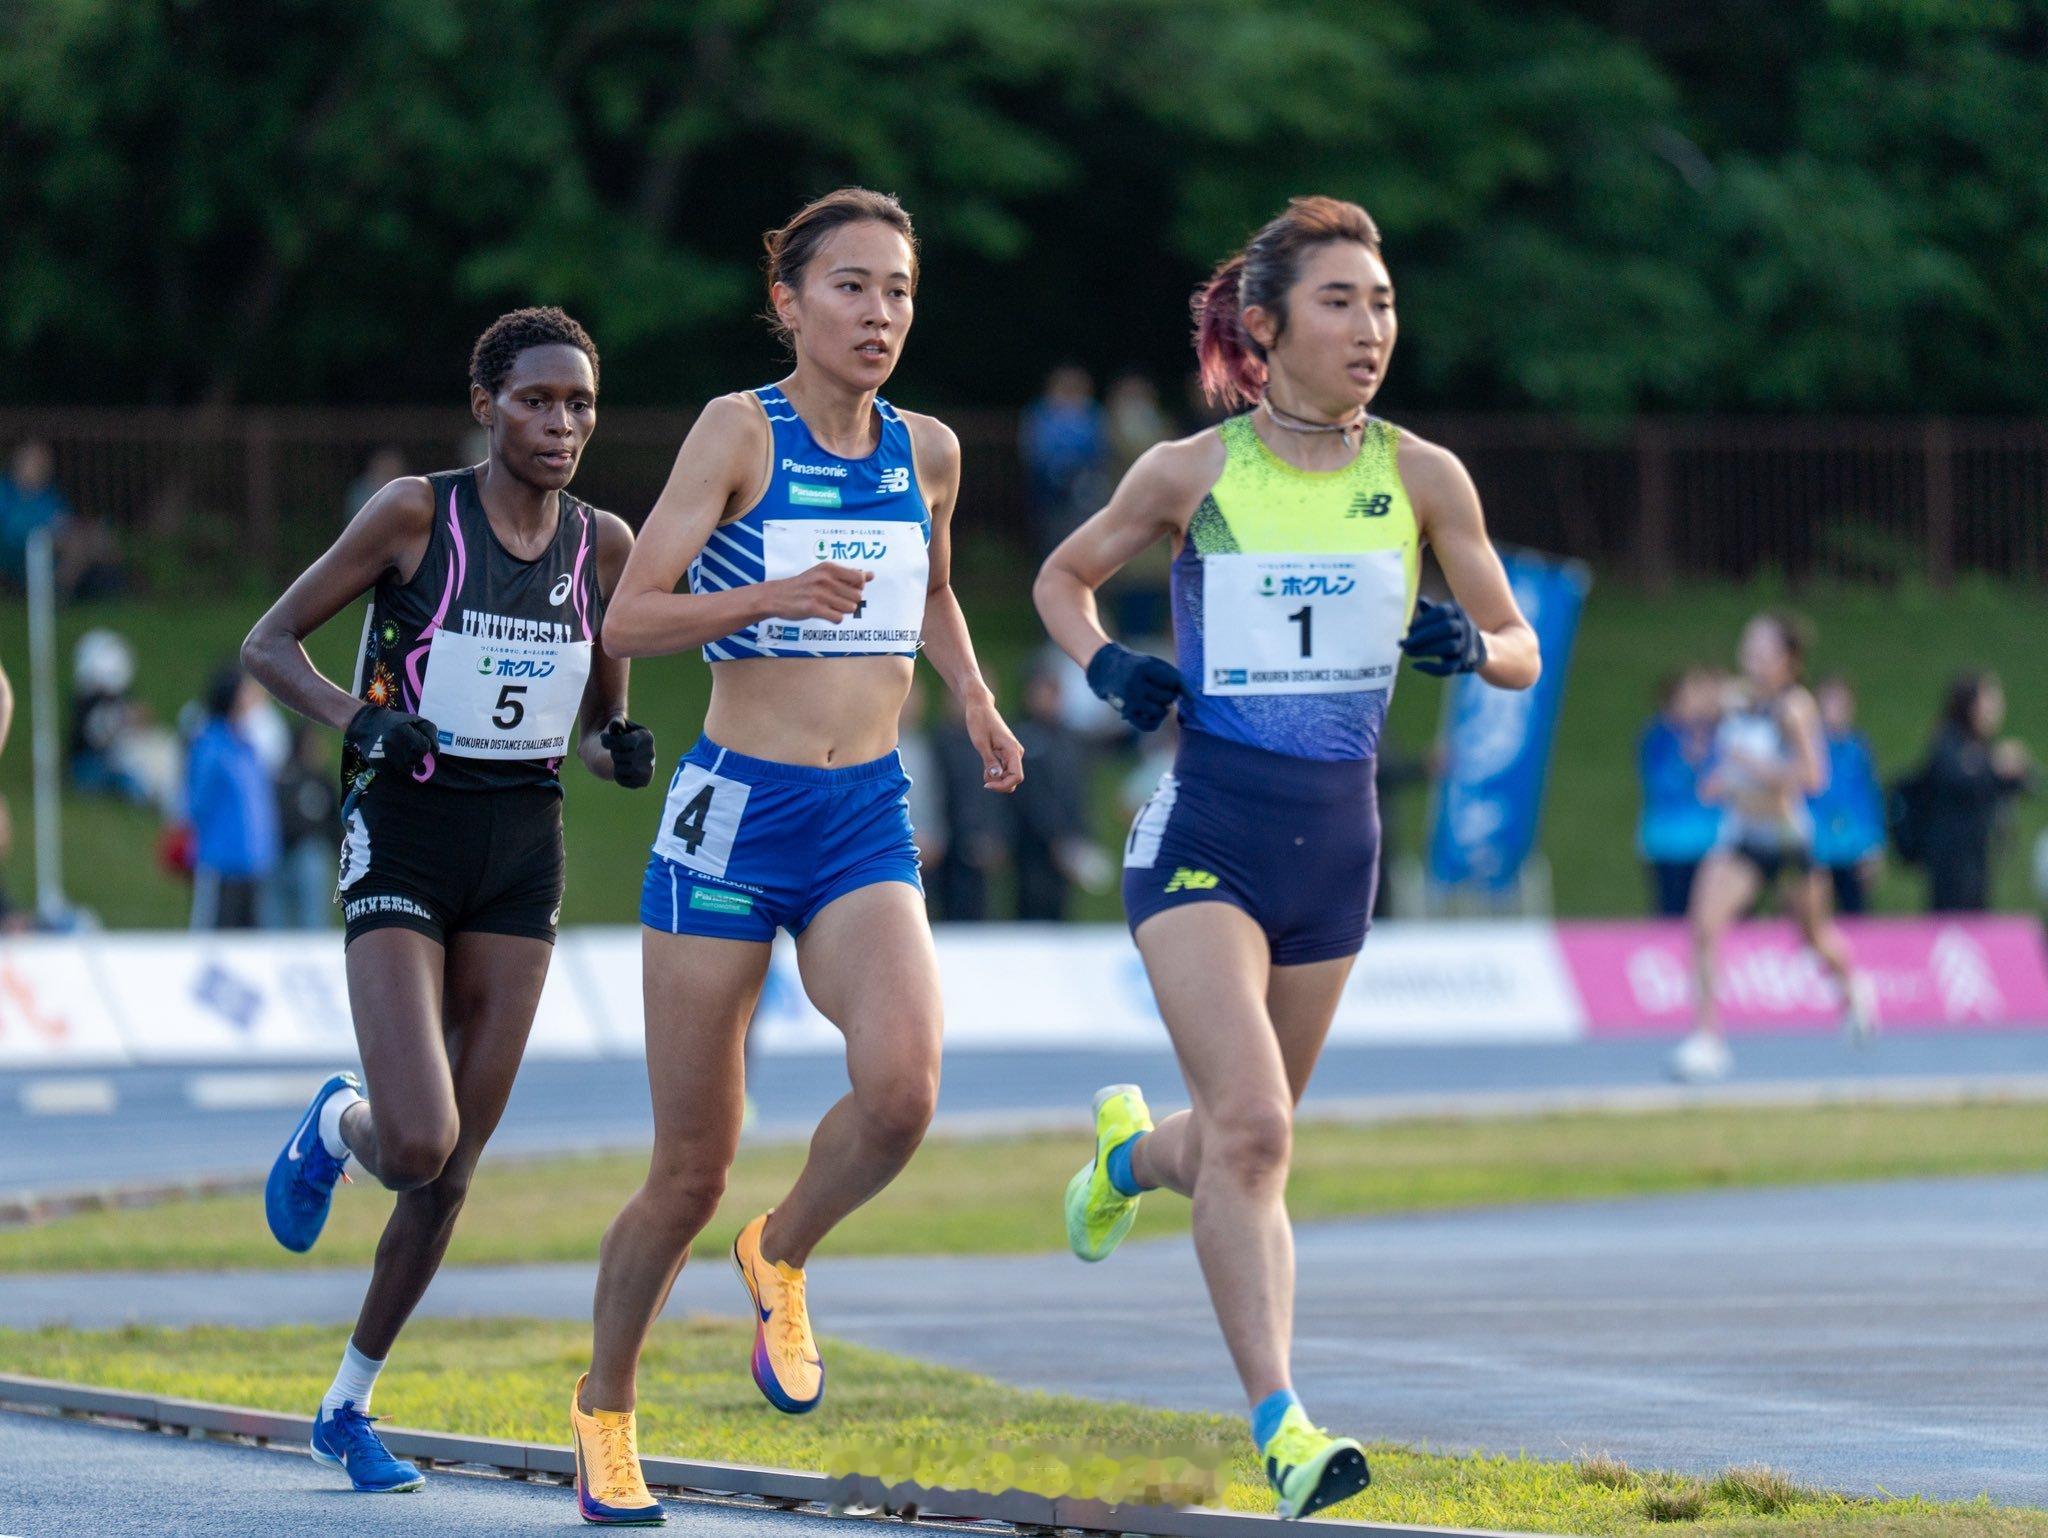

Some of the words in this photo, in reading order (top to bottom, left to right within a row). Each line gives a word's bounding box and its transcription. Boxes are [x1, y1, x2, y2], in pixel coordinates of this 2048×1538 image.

[782, 459, 848, 477] Panasonic
[830, 541, 887, 560] ホクレン
[1281, 576, 1355, 596] ホクレン
[462, 609, 571, 643] UNIVERSAL
[802, 629, 837, 641] HOKUREN
[838, 629, 872, 642] DISTANCE
[1288, 605, 1312, 658] 1
[496, 659, 555, 678] ホクレン
[492, 685, 528, 730] 5
[455, 736, 489, 749] HOKUREN
[489, 739, 522, 750] DISTANCE
[521, 737, 553, 750] CHALLENGE
[673, 784, 715, 856] 4
[345, 896, 431, 922] UNIVERSAL
